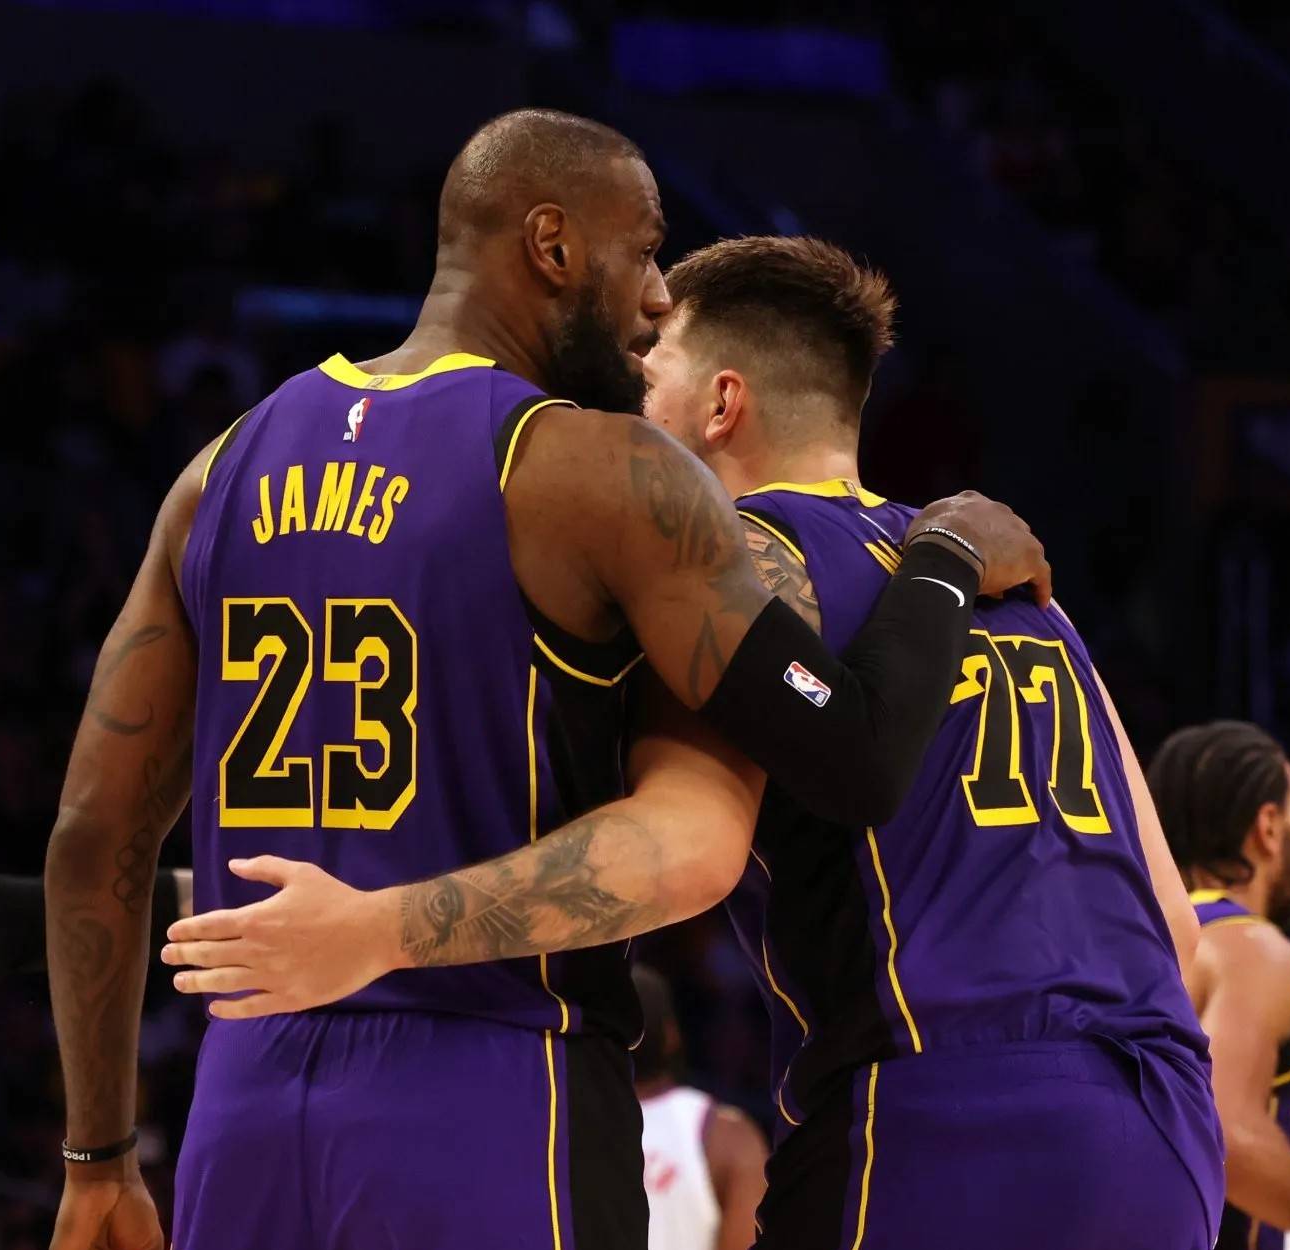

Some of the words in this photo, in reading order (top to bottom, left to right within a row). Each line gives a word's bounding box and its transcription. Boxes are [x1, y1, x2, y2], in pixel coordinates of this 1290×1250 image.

[252, 462, 409, 545] JAMES
[931, 527, 975, 551] PROMISE
[219, 597, 418, 830] 23
[949, 629, 1112, 834] 77
